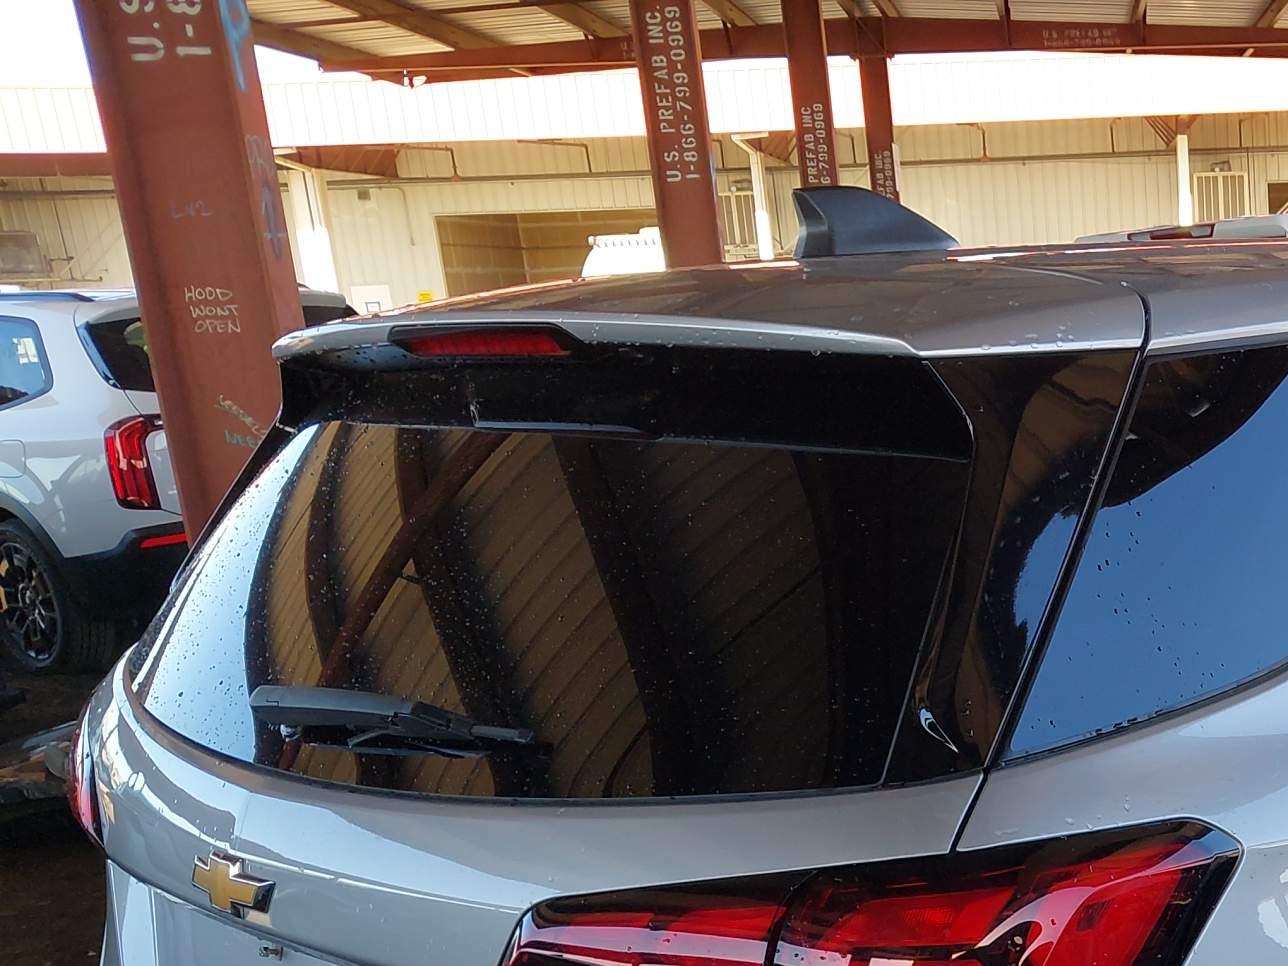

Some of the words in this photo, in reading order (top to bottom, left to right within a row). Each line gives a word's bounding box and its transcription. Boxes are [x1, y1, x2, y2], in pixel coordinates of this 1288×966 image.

[645, 4, 665, 44] INC.
[651, 55, 676, 133] PREFAB
[664, 5, 700, 179] 1-866-799-0969
[664, 144, 682, 182] U.S.
[803, 133, 819, 184] PREFAB
[184, 284, 233, 302] HOOD
[190, 304, 239, 318] WONT
[194, 318, 241, 334] OPEN
